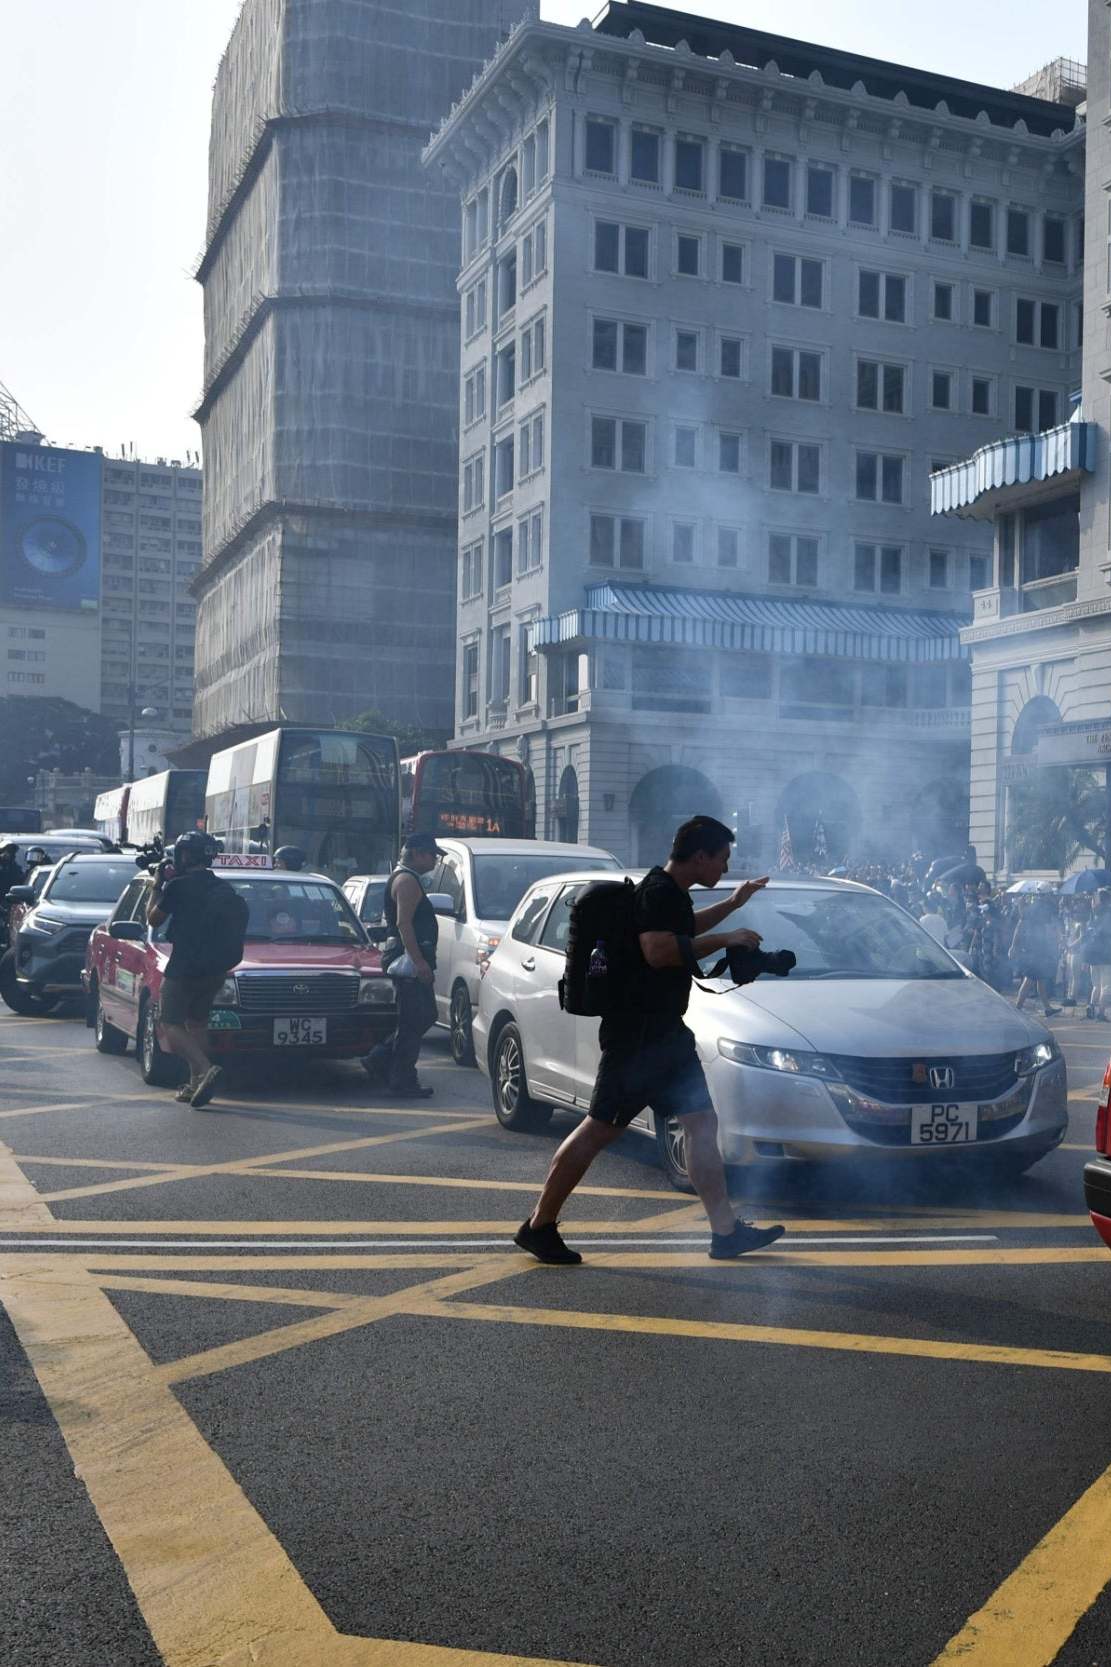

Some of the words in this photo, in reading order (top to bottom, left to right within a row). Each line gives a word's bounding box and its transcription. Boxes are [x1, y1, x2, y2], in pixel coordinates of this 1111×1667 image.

[487, 818, 500, 832] 1A
[218, 855, 267, 866] TAXI
[290, 1018, 311, 1032] WC
[277, 1031, 322, 1044] 9345
[931, 1104, 959, 1122] PC
[920, 1122, 969, 1142] 5971
